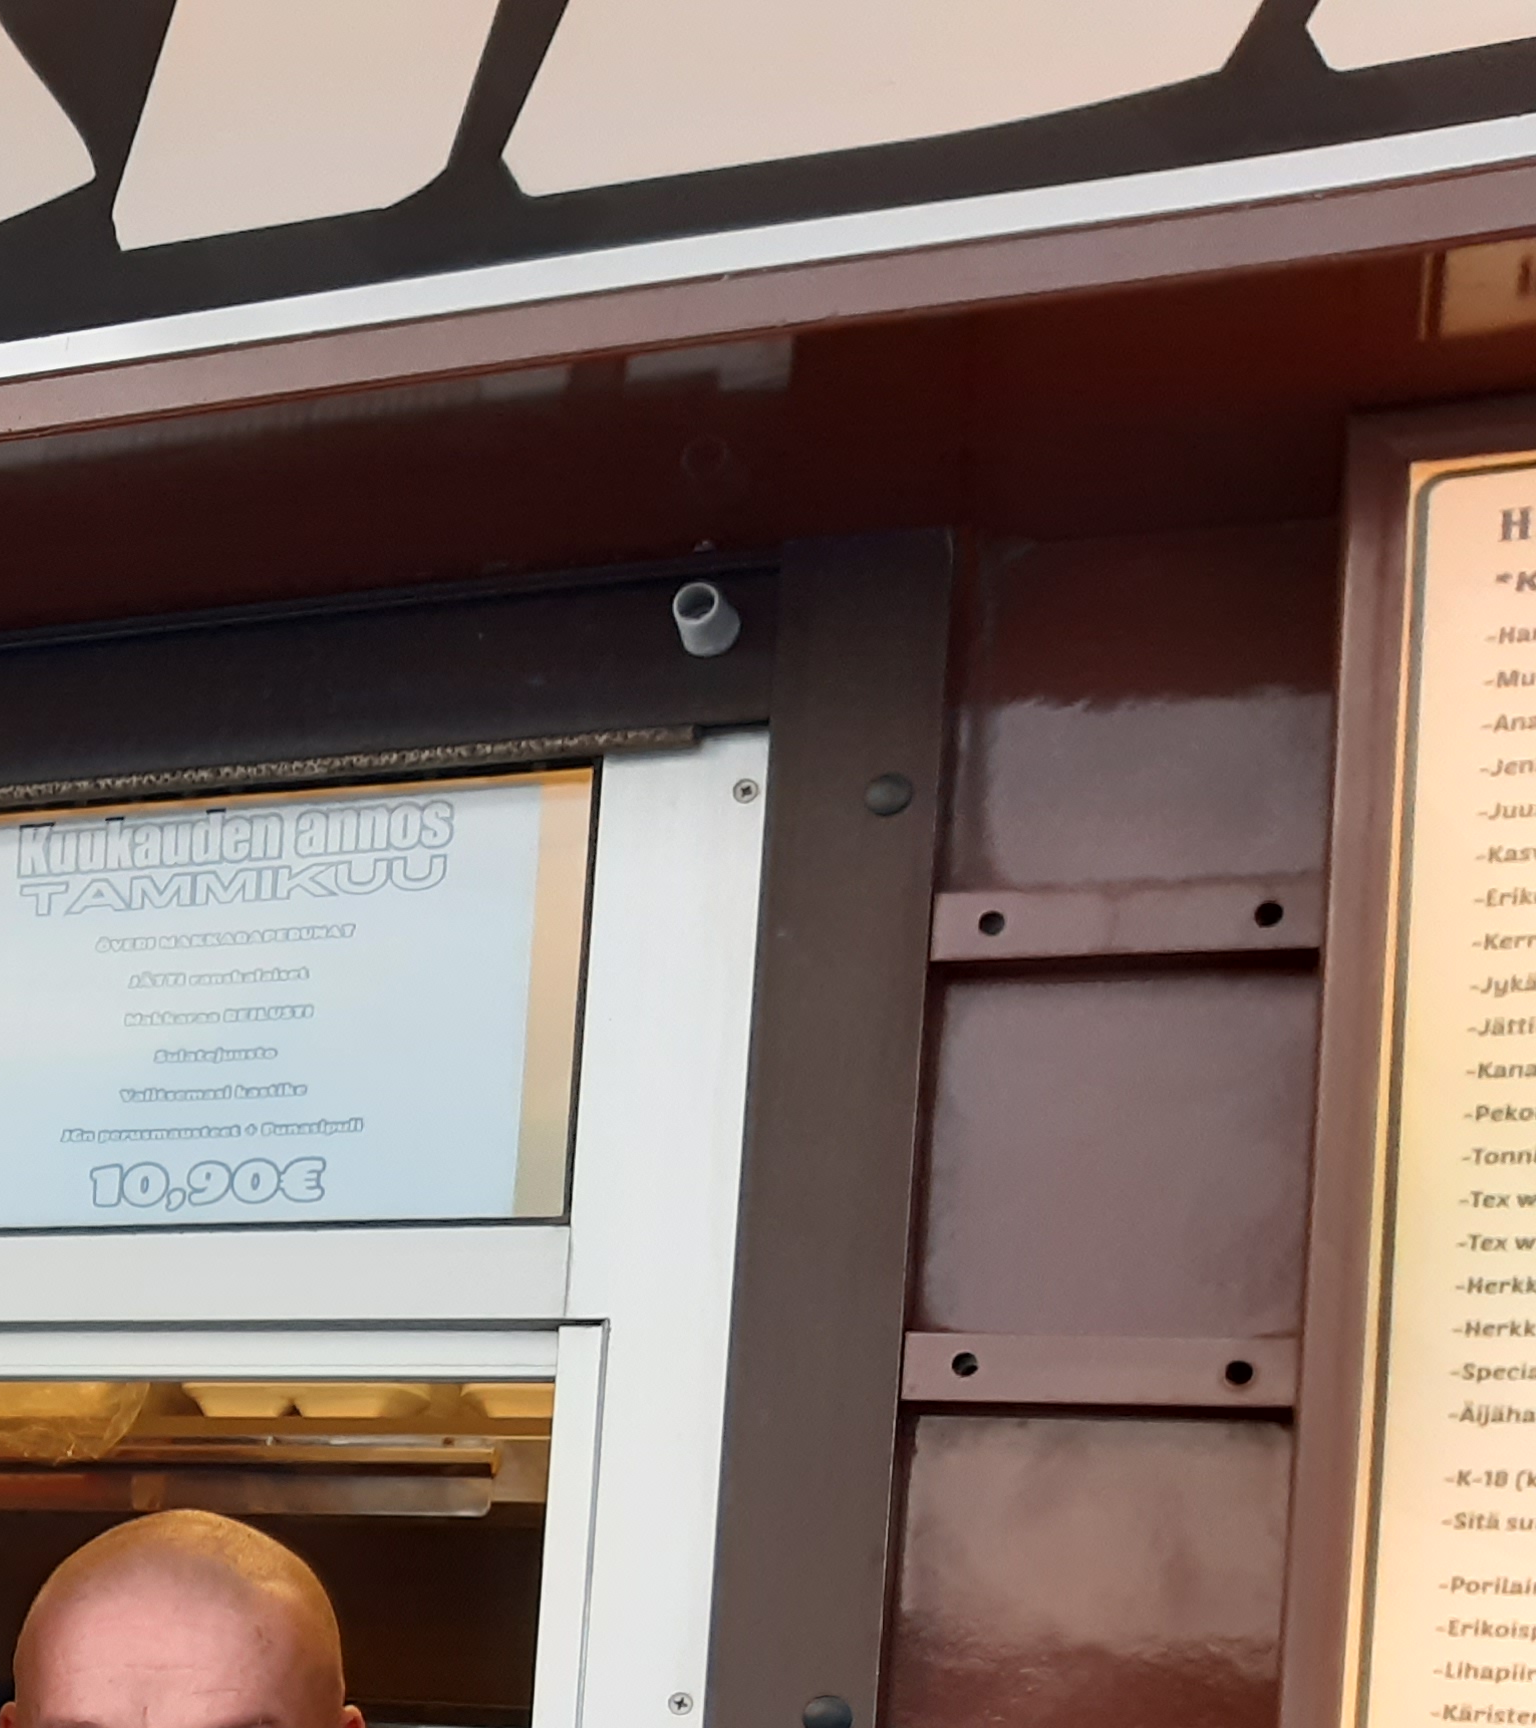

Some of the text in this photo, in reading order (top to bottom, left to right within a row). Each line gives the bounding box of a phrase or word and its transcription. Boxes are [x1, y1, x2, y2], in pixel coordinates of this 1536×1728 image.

[1478, 757, 1536, 778] -Jen
[1476, 801, 1536, 821] -Juu
[17, 801, 454, 878] Kuukauden annos
[20, 854, 448, 917] TAMMIKUU
[1473, 887, 1536, 908] -Erik
[1463, 1104, 1536, 1123] -Peko
[90, 1157, 326, 1212] 10,90€
[1505, 1513, 1536, 1532] su
[1430, 1703, 1536, 1726] -Käriste
